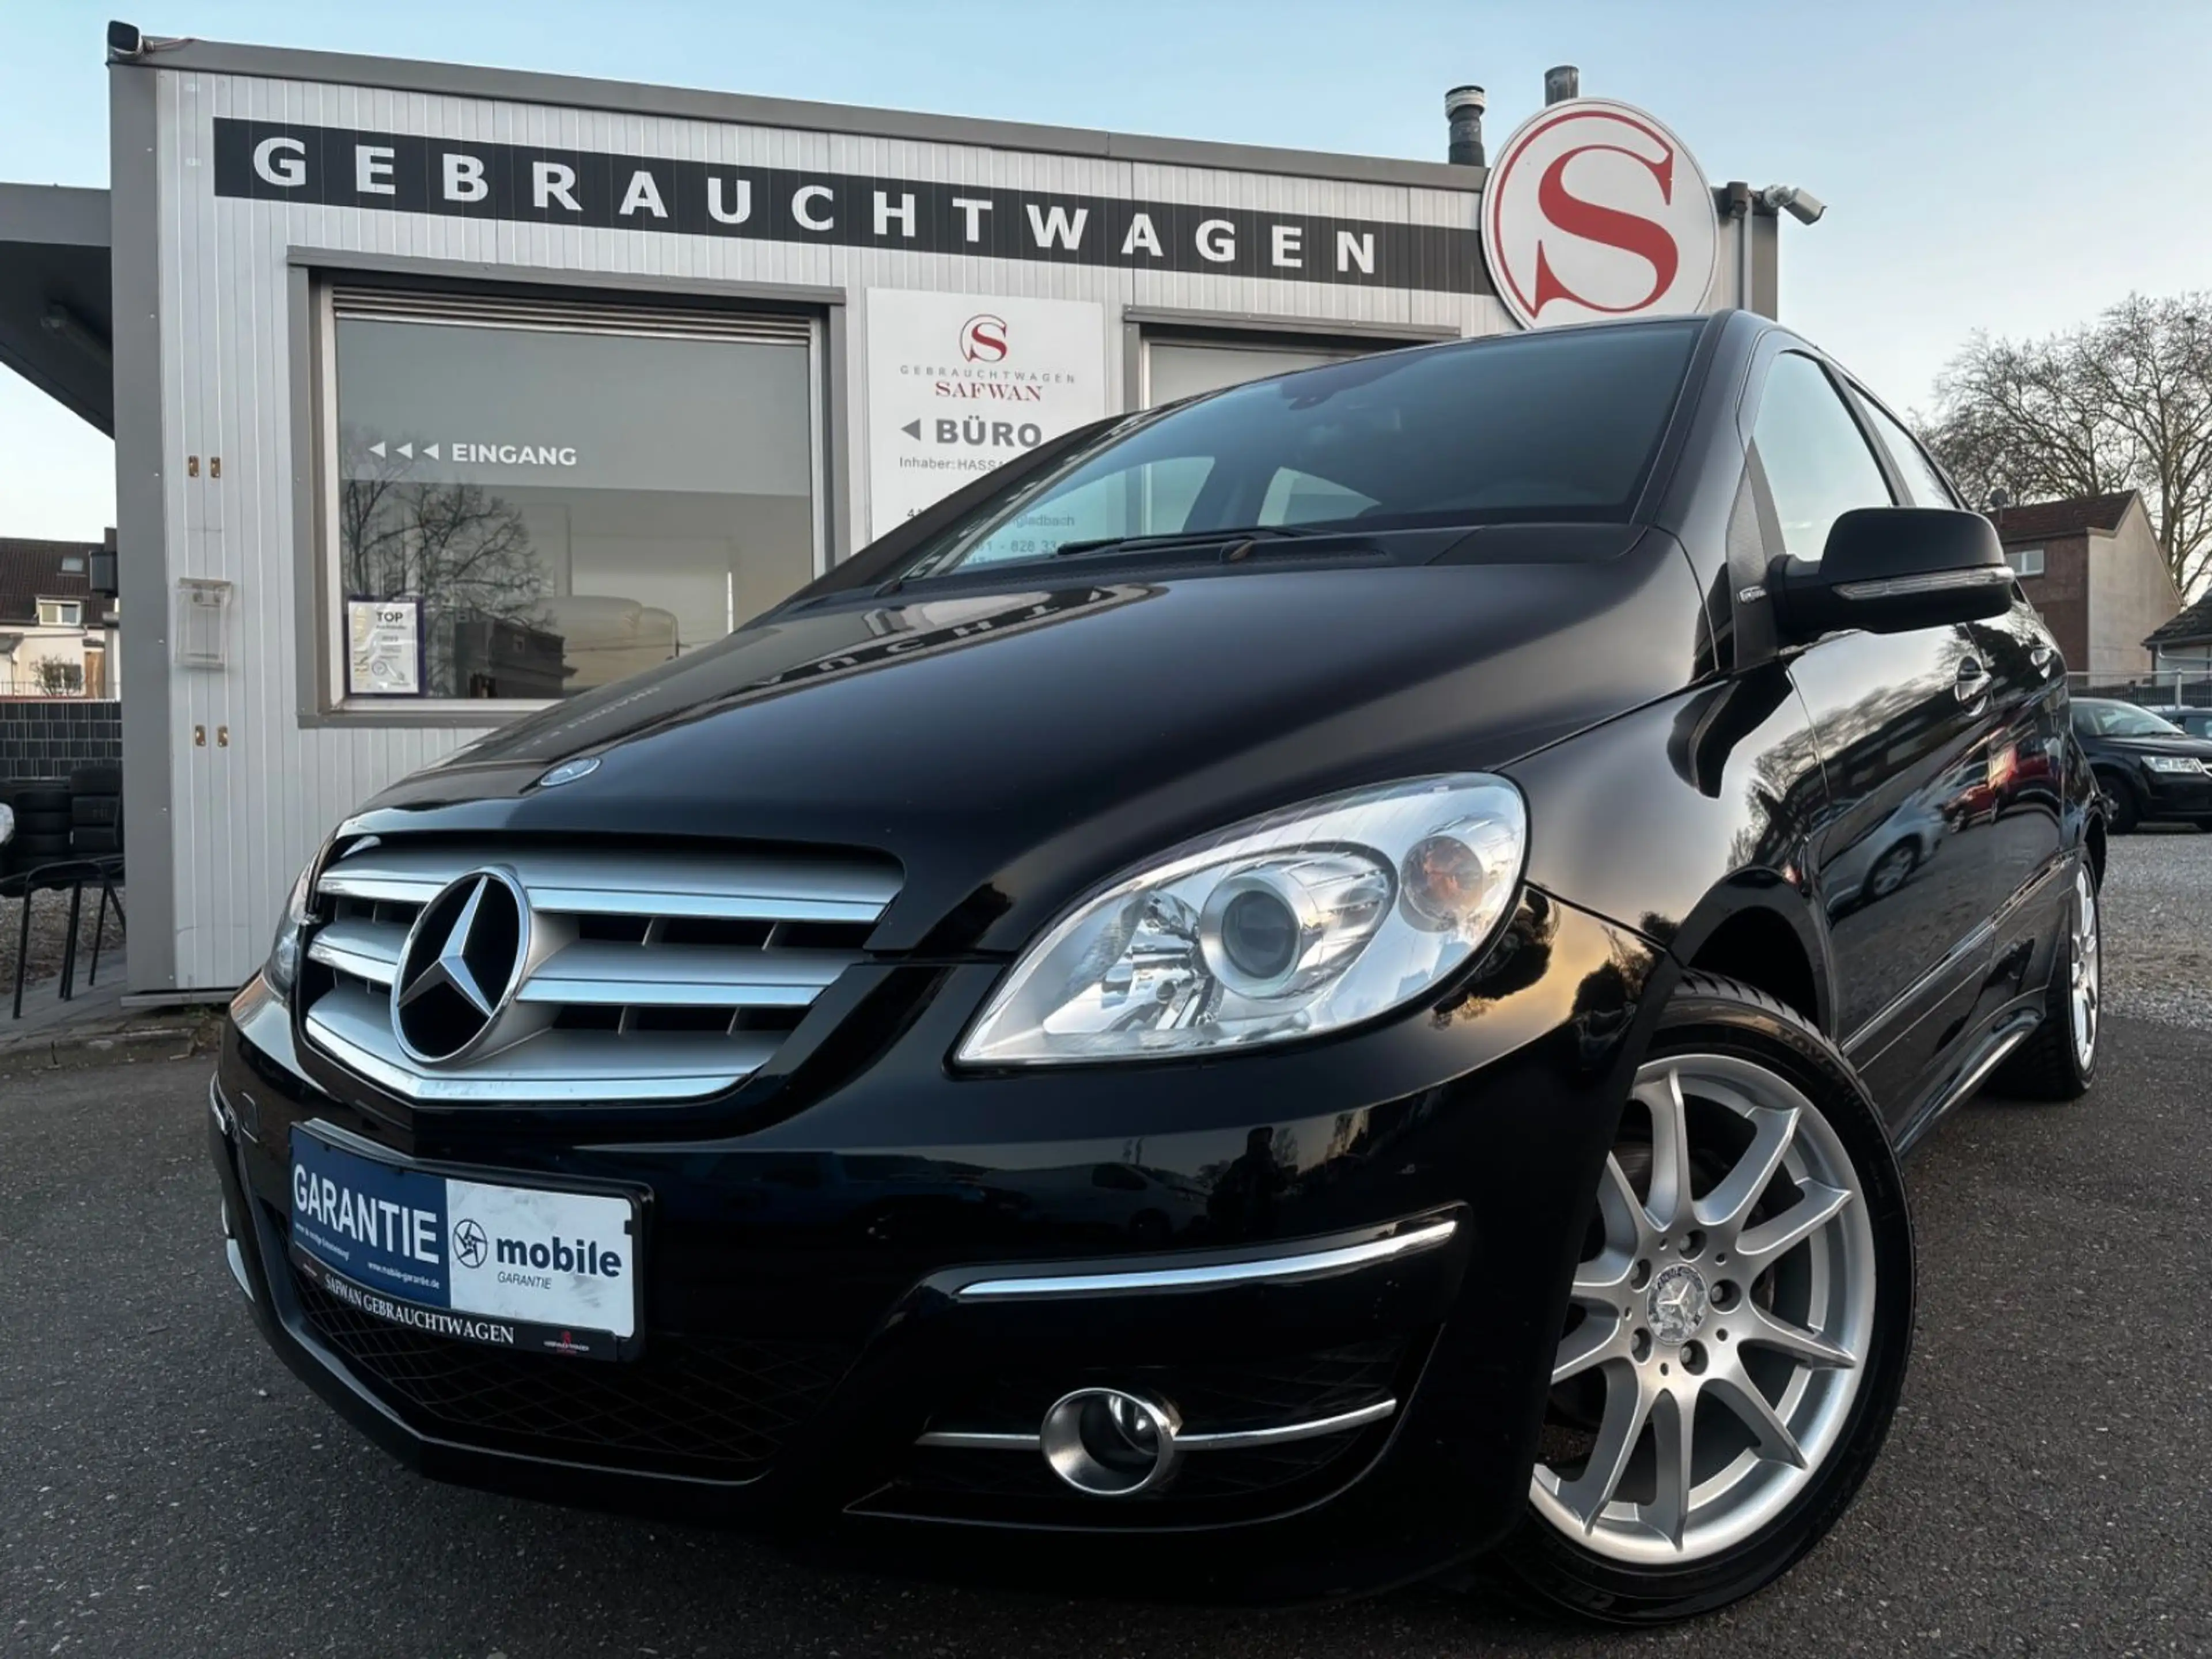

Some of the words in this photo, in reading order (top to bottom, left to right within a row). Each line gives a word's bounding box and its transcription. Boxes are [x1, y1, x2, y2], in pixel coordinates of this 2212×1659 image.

[253, 136, 1375, 275] GEBRAUCHTWAGEN
[1494, 109, 1679, 319] S
[959, 313, 1007, 362] S
[900, 365, 1075, 384] GEBRAUCHTWAGEN
[935, 381, 1043, 402] SAFWAN
[935, 414, 1042, 448] BÜRO
[452, 442, 577, 466] EINGANG
[376, 611, 403, 623] TOP
[294, 1163, 440, 1264] GARANTIE
[496, 1236, 622, 1278] mobile
[497, 1271, 552, 1289] GARANTIE
[324, 1273, 362, 1308] SAFWAN
[363, 1294, 514, 1344] GEBRAUCHTWAGEN
